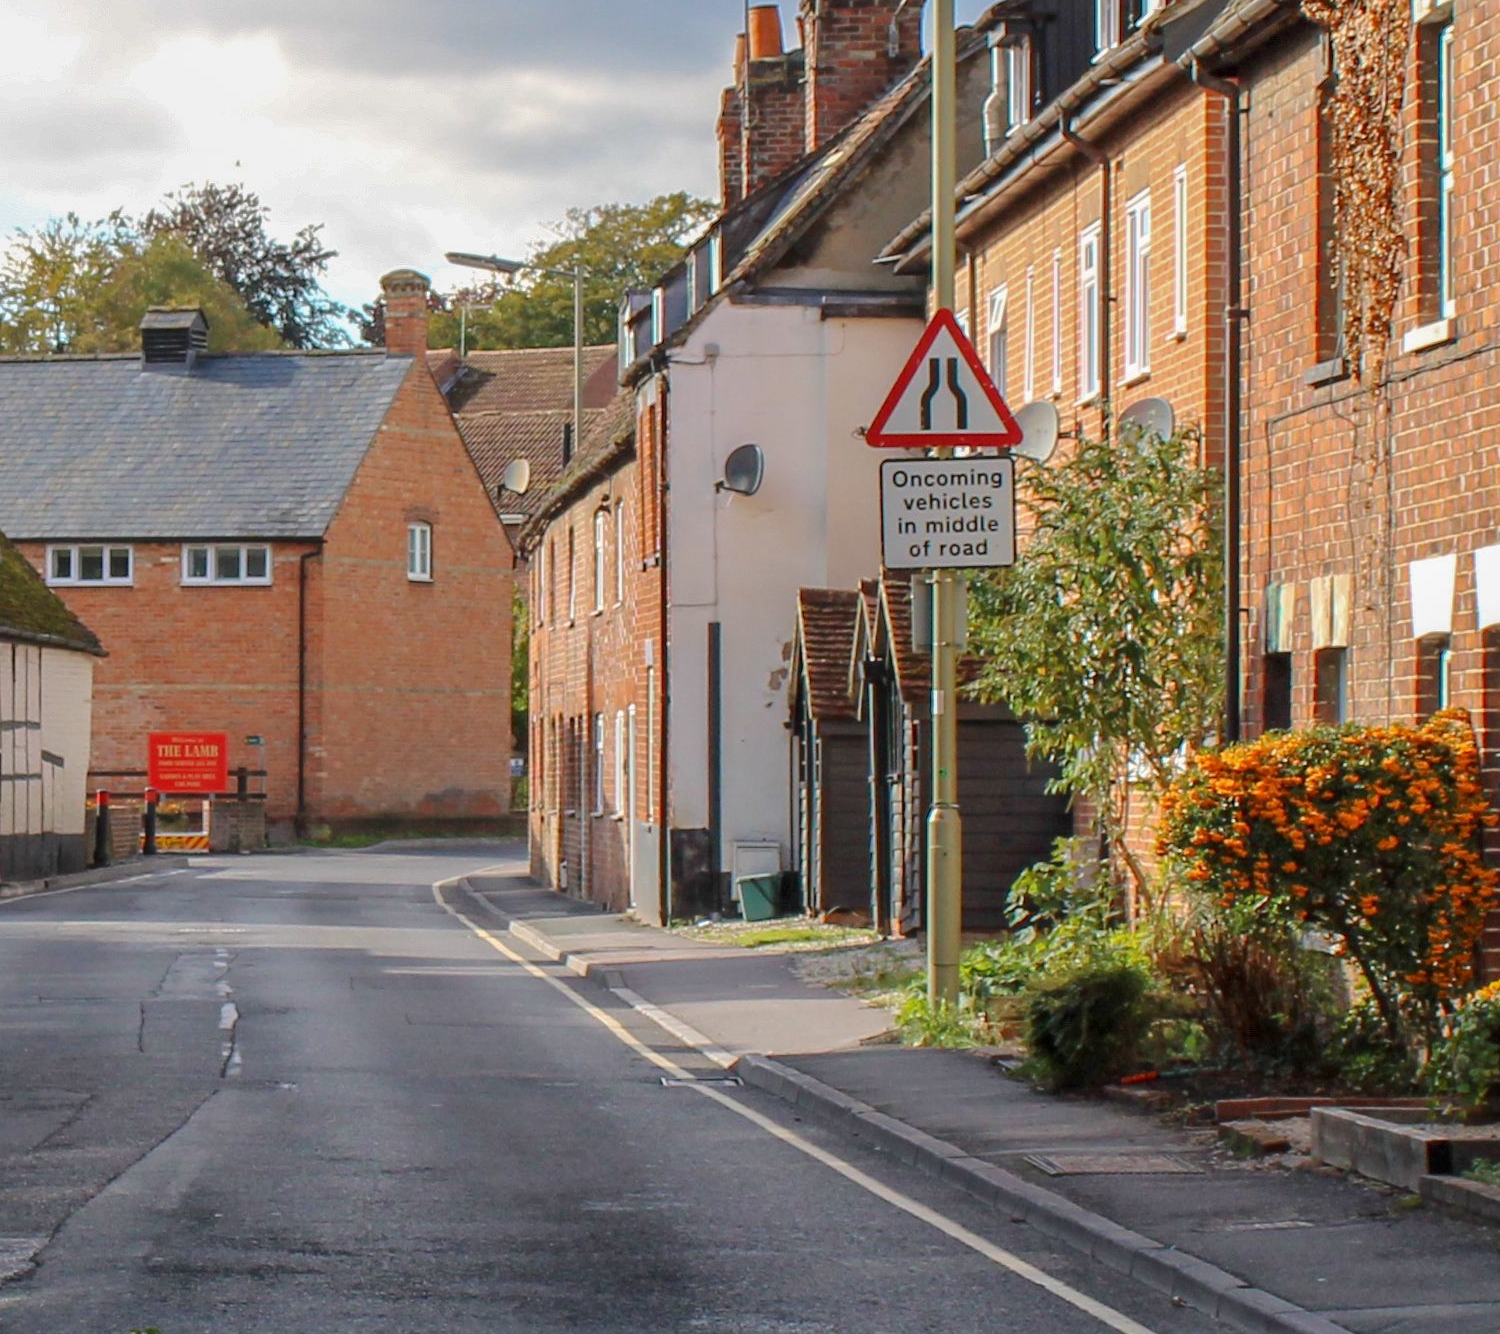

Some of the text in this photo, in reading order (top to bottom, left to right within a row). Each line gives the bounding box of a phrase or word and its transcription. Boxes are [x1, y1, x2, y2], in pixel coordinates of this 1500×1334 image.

[892, 468, 1003, 489] Oncoming
[903, 492, 993, 510] vehicles
[898, 515, 999, 534] in middle
[909, 538, 988, 557] of road
[156, 745, 219, 757] THE LAMB
